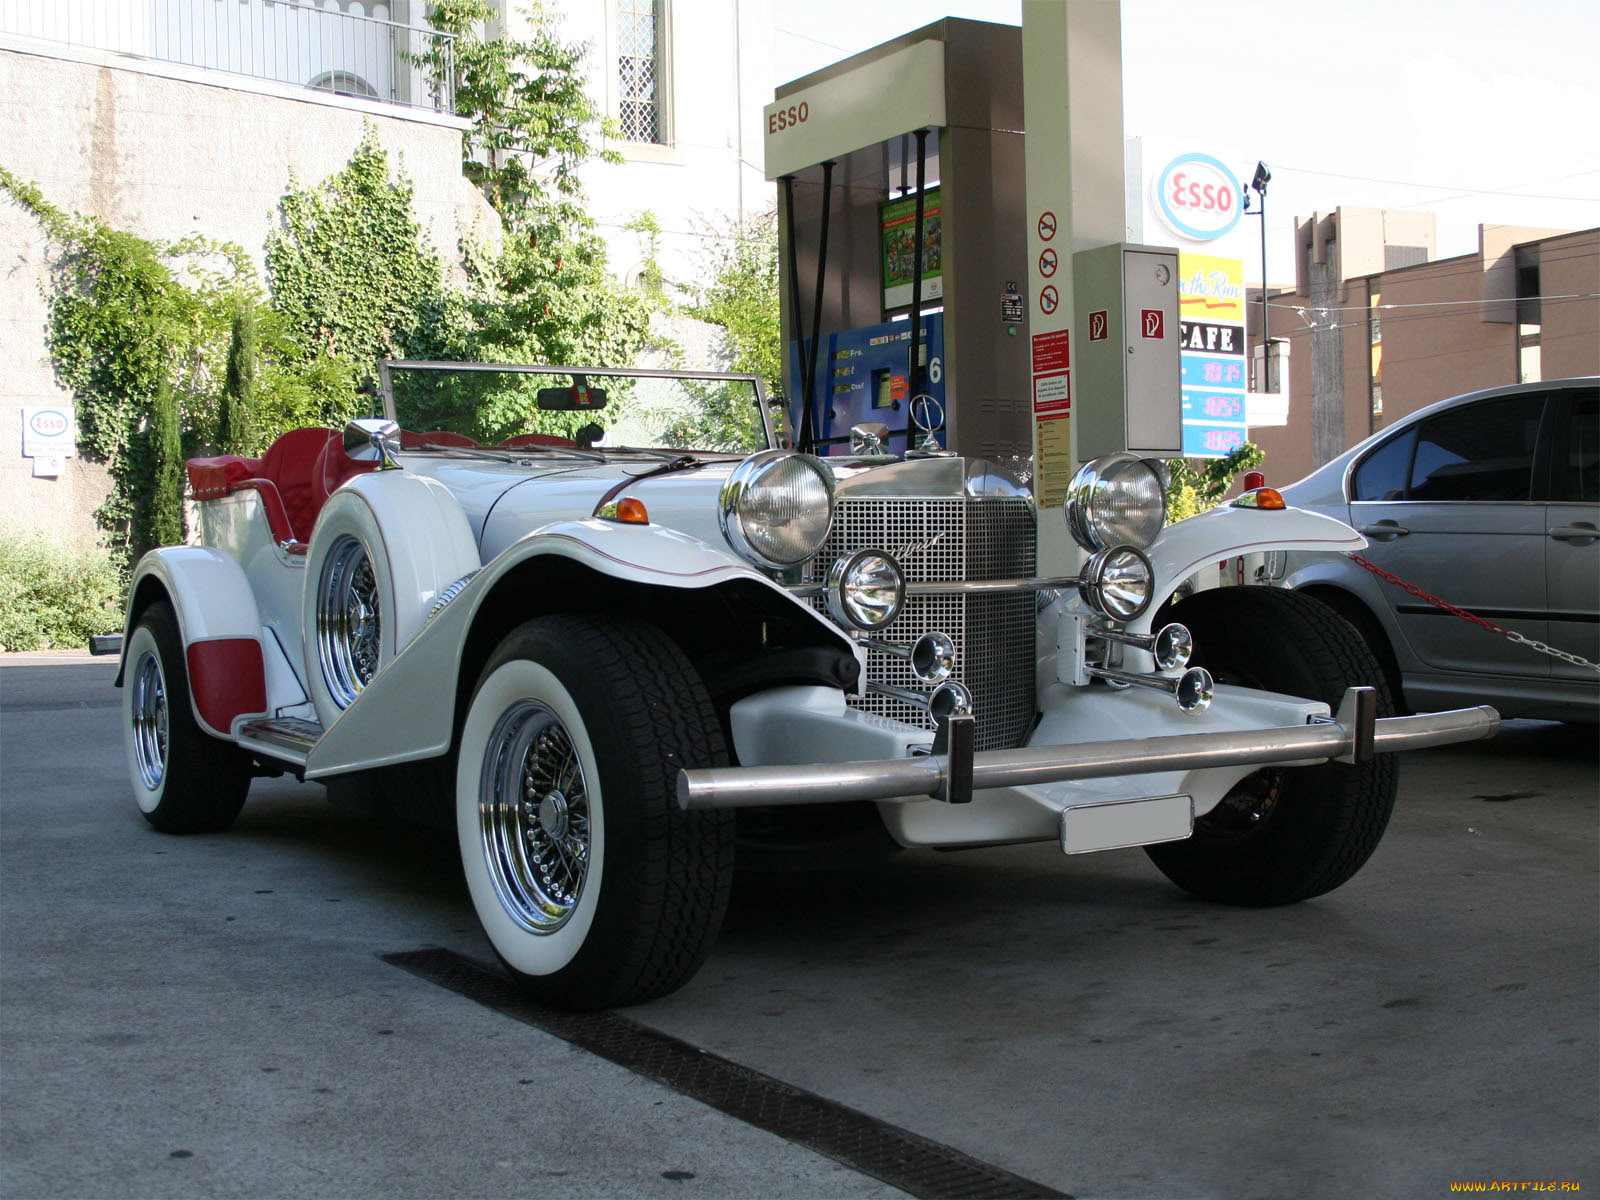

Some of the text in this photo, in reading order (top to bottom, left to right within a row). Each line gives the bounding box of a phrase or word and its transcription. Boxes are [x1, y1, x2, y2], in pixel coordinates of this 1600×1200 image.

[768, 101, 809, 135] ESSO
[1208, 271, 1242, 301] Run
[929, 356, 942, 385] 6
